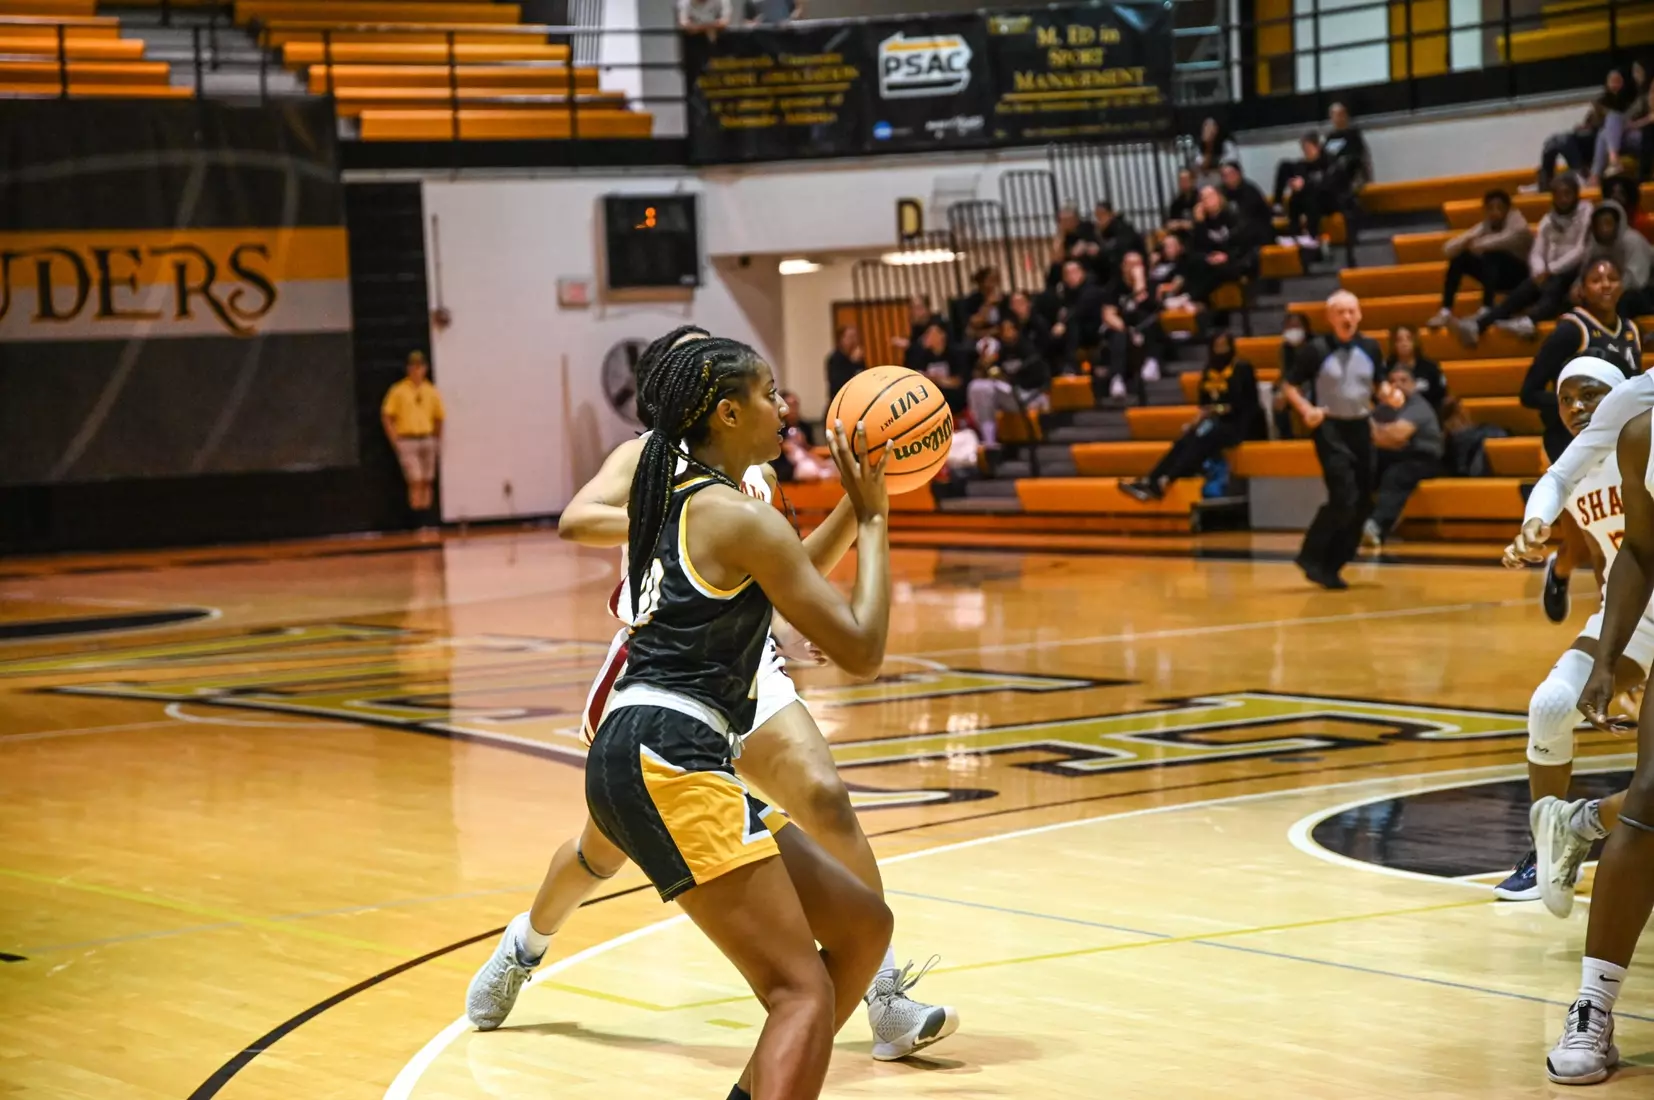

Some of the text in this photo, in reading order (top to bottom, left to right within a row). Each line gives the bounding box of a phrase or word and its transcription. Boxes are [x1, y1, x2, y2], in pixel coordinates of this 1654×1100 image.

[884, 51, 965, 77] PSAC
[893, 413, 952, 460] Wilson
[1577, 486, 1625, 526] SHA
